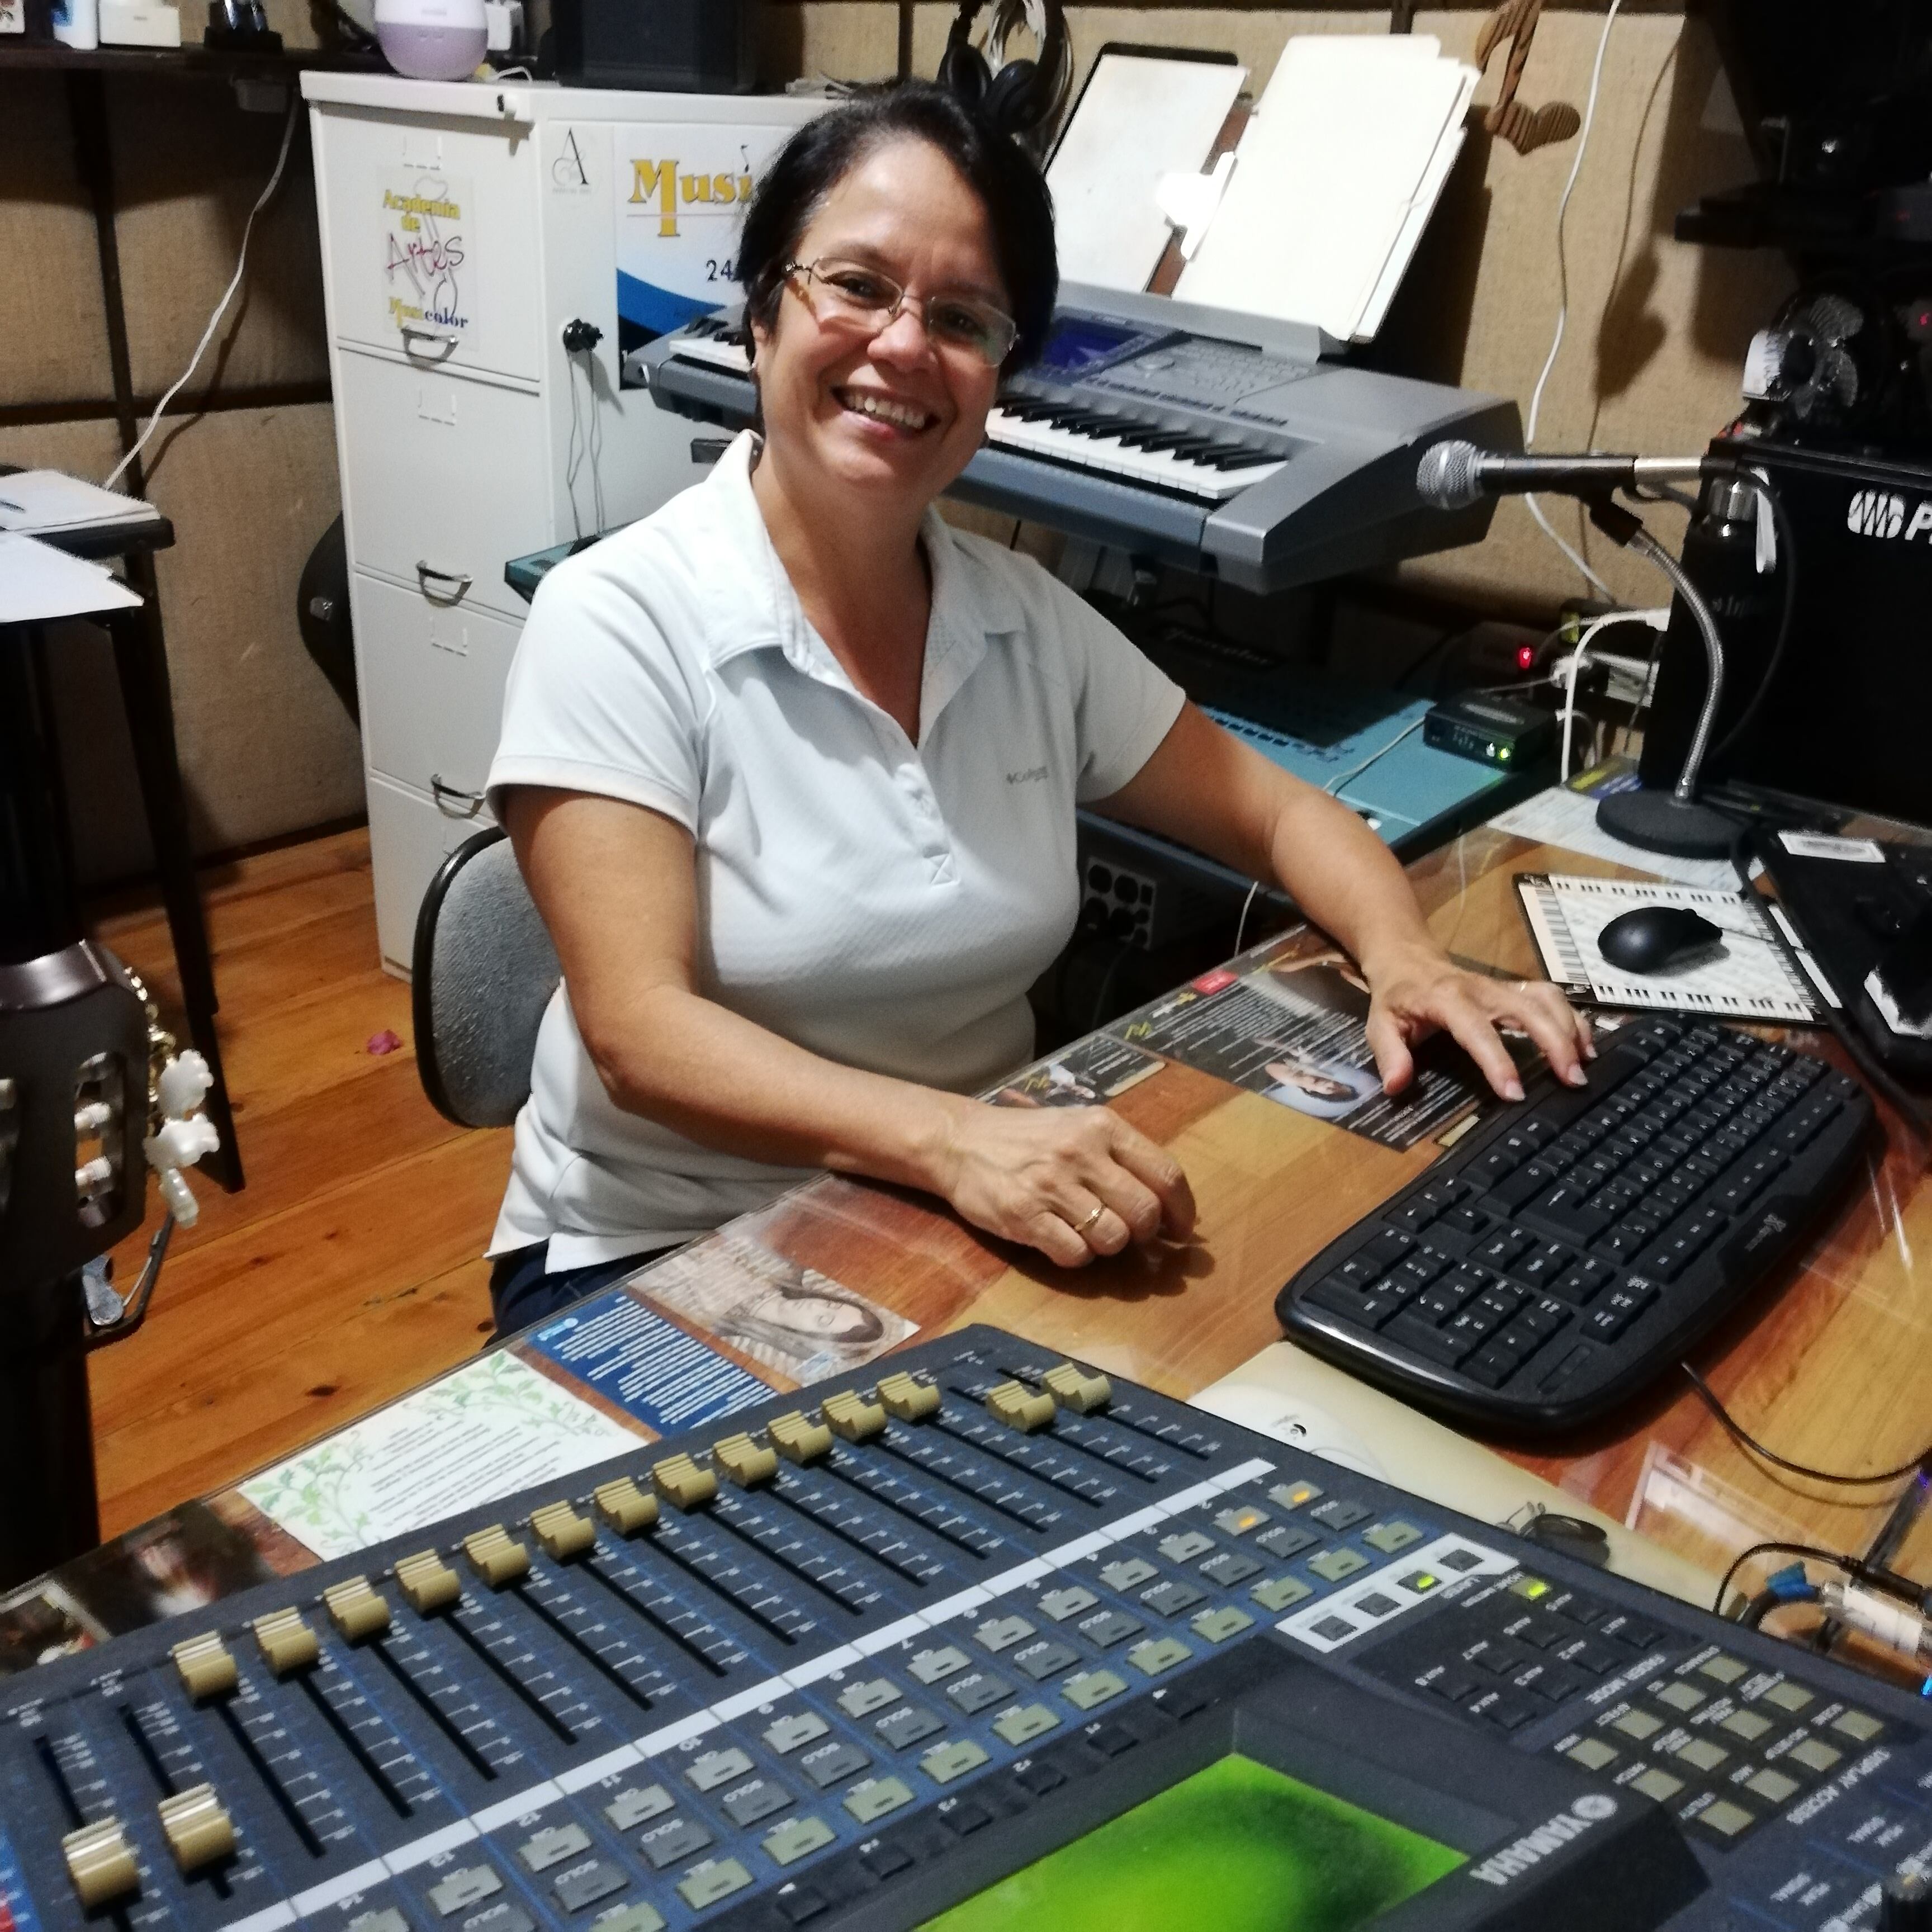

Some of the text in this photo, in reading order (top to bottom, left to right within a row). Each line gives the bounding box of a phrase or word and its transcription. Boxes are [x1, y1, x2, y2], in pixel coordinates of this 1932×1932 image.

[383, 188, 460, 220] Academia
[401, 211, 421, 233] de
[387, 231, 464, 295] Artes
[1905, 500, 1932, 544] P
[1470, 1813, 1592, 1886] YAMAHA
